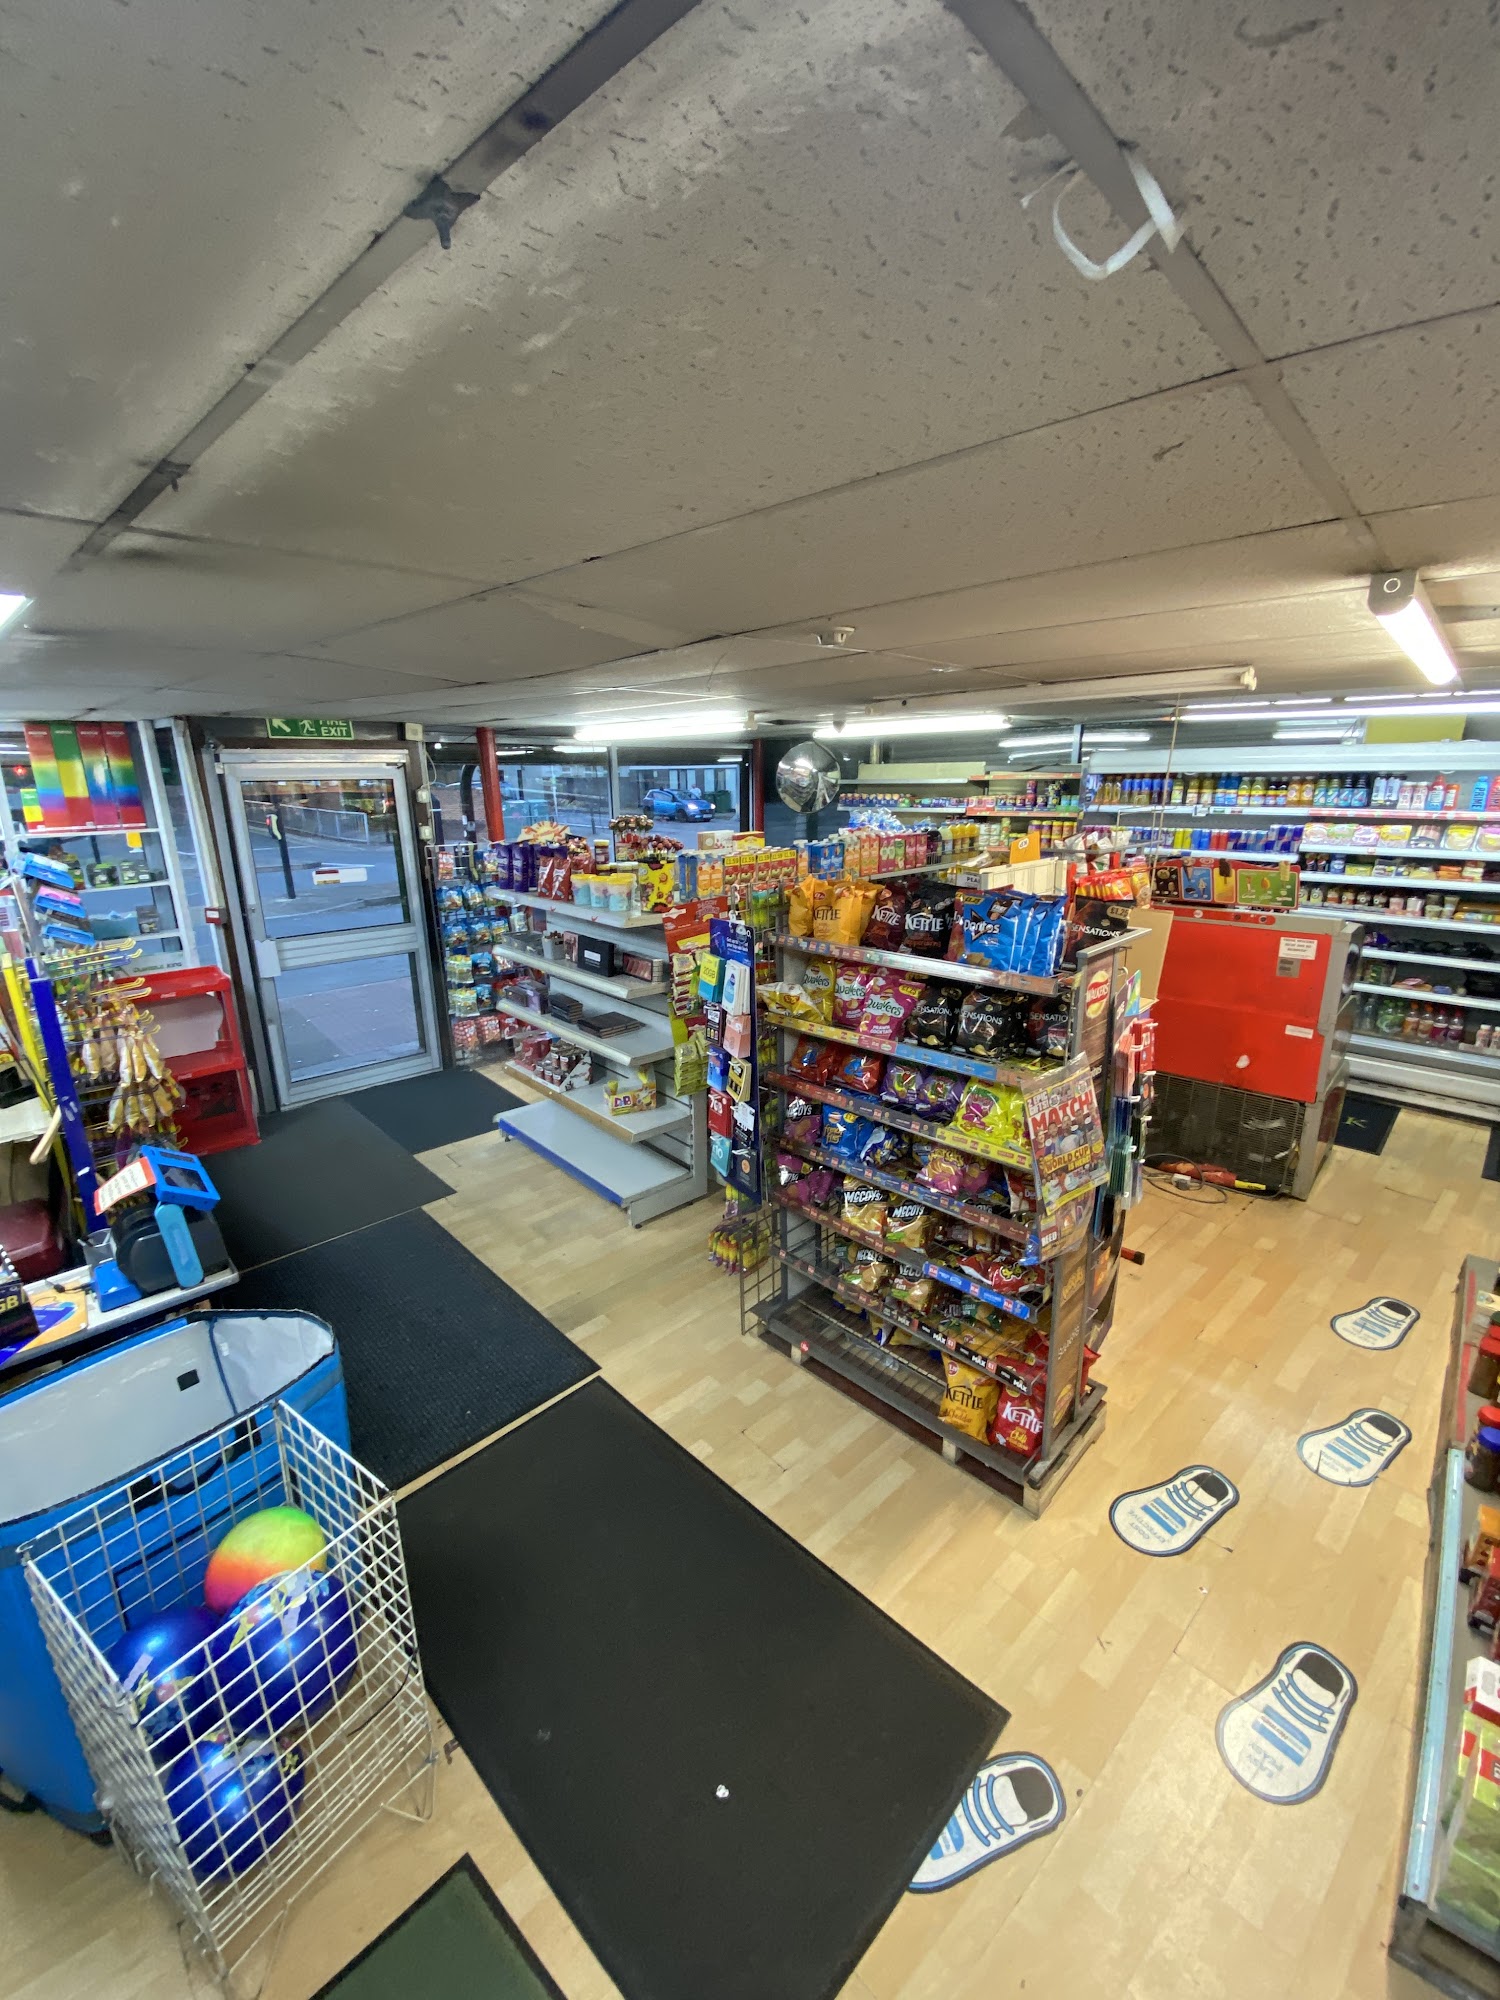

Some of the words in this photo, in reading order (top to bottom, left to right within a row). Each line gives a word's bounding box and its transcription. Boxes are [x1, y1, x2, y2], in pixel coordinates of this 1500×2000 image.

[321, 727, 348, 737] EXIT
[1472, 787, 1486, 808] PRIME
[871, 905, 901, 926] KETTLE
[1110, 906, 1129, 918] £1.25
[905, 912, 944, 932] KETTLE
[963, 919, 1001, 934] Doritos
[1071, 923, 1121, 938] SENSATIONS
[803, 973, 830, 988] Quavers
[835, 982, 866, 998] Quavers
[1086, 982, 1110, 1002] WALKERS
[866, 998, 903, 1017] Quavers
[1030, 1011, 1069, 1023] SENSATIO
[1046, 1152, 1073, 1171] WORLD
[1074, 1146, 1090, 1160] CUP
[932, 1333, 947, 1345] MAX
[971, 1355, 986, 1368] MAX
[1013, 1379, 1027, 1393] MAX
[945, 1384, 983, 1410] KETTLE
[1002, 1401, 1043, 1434] KETTLE
